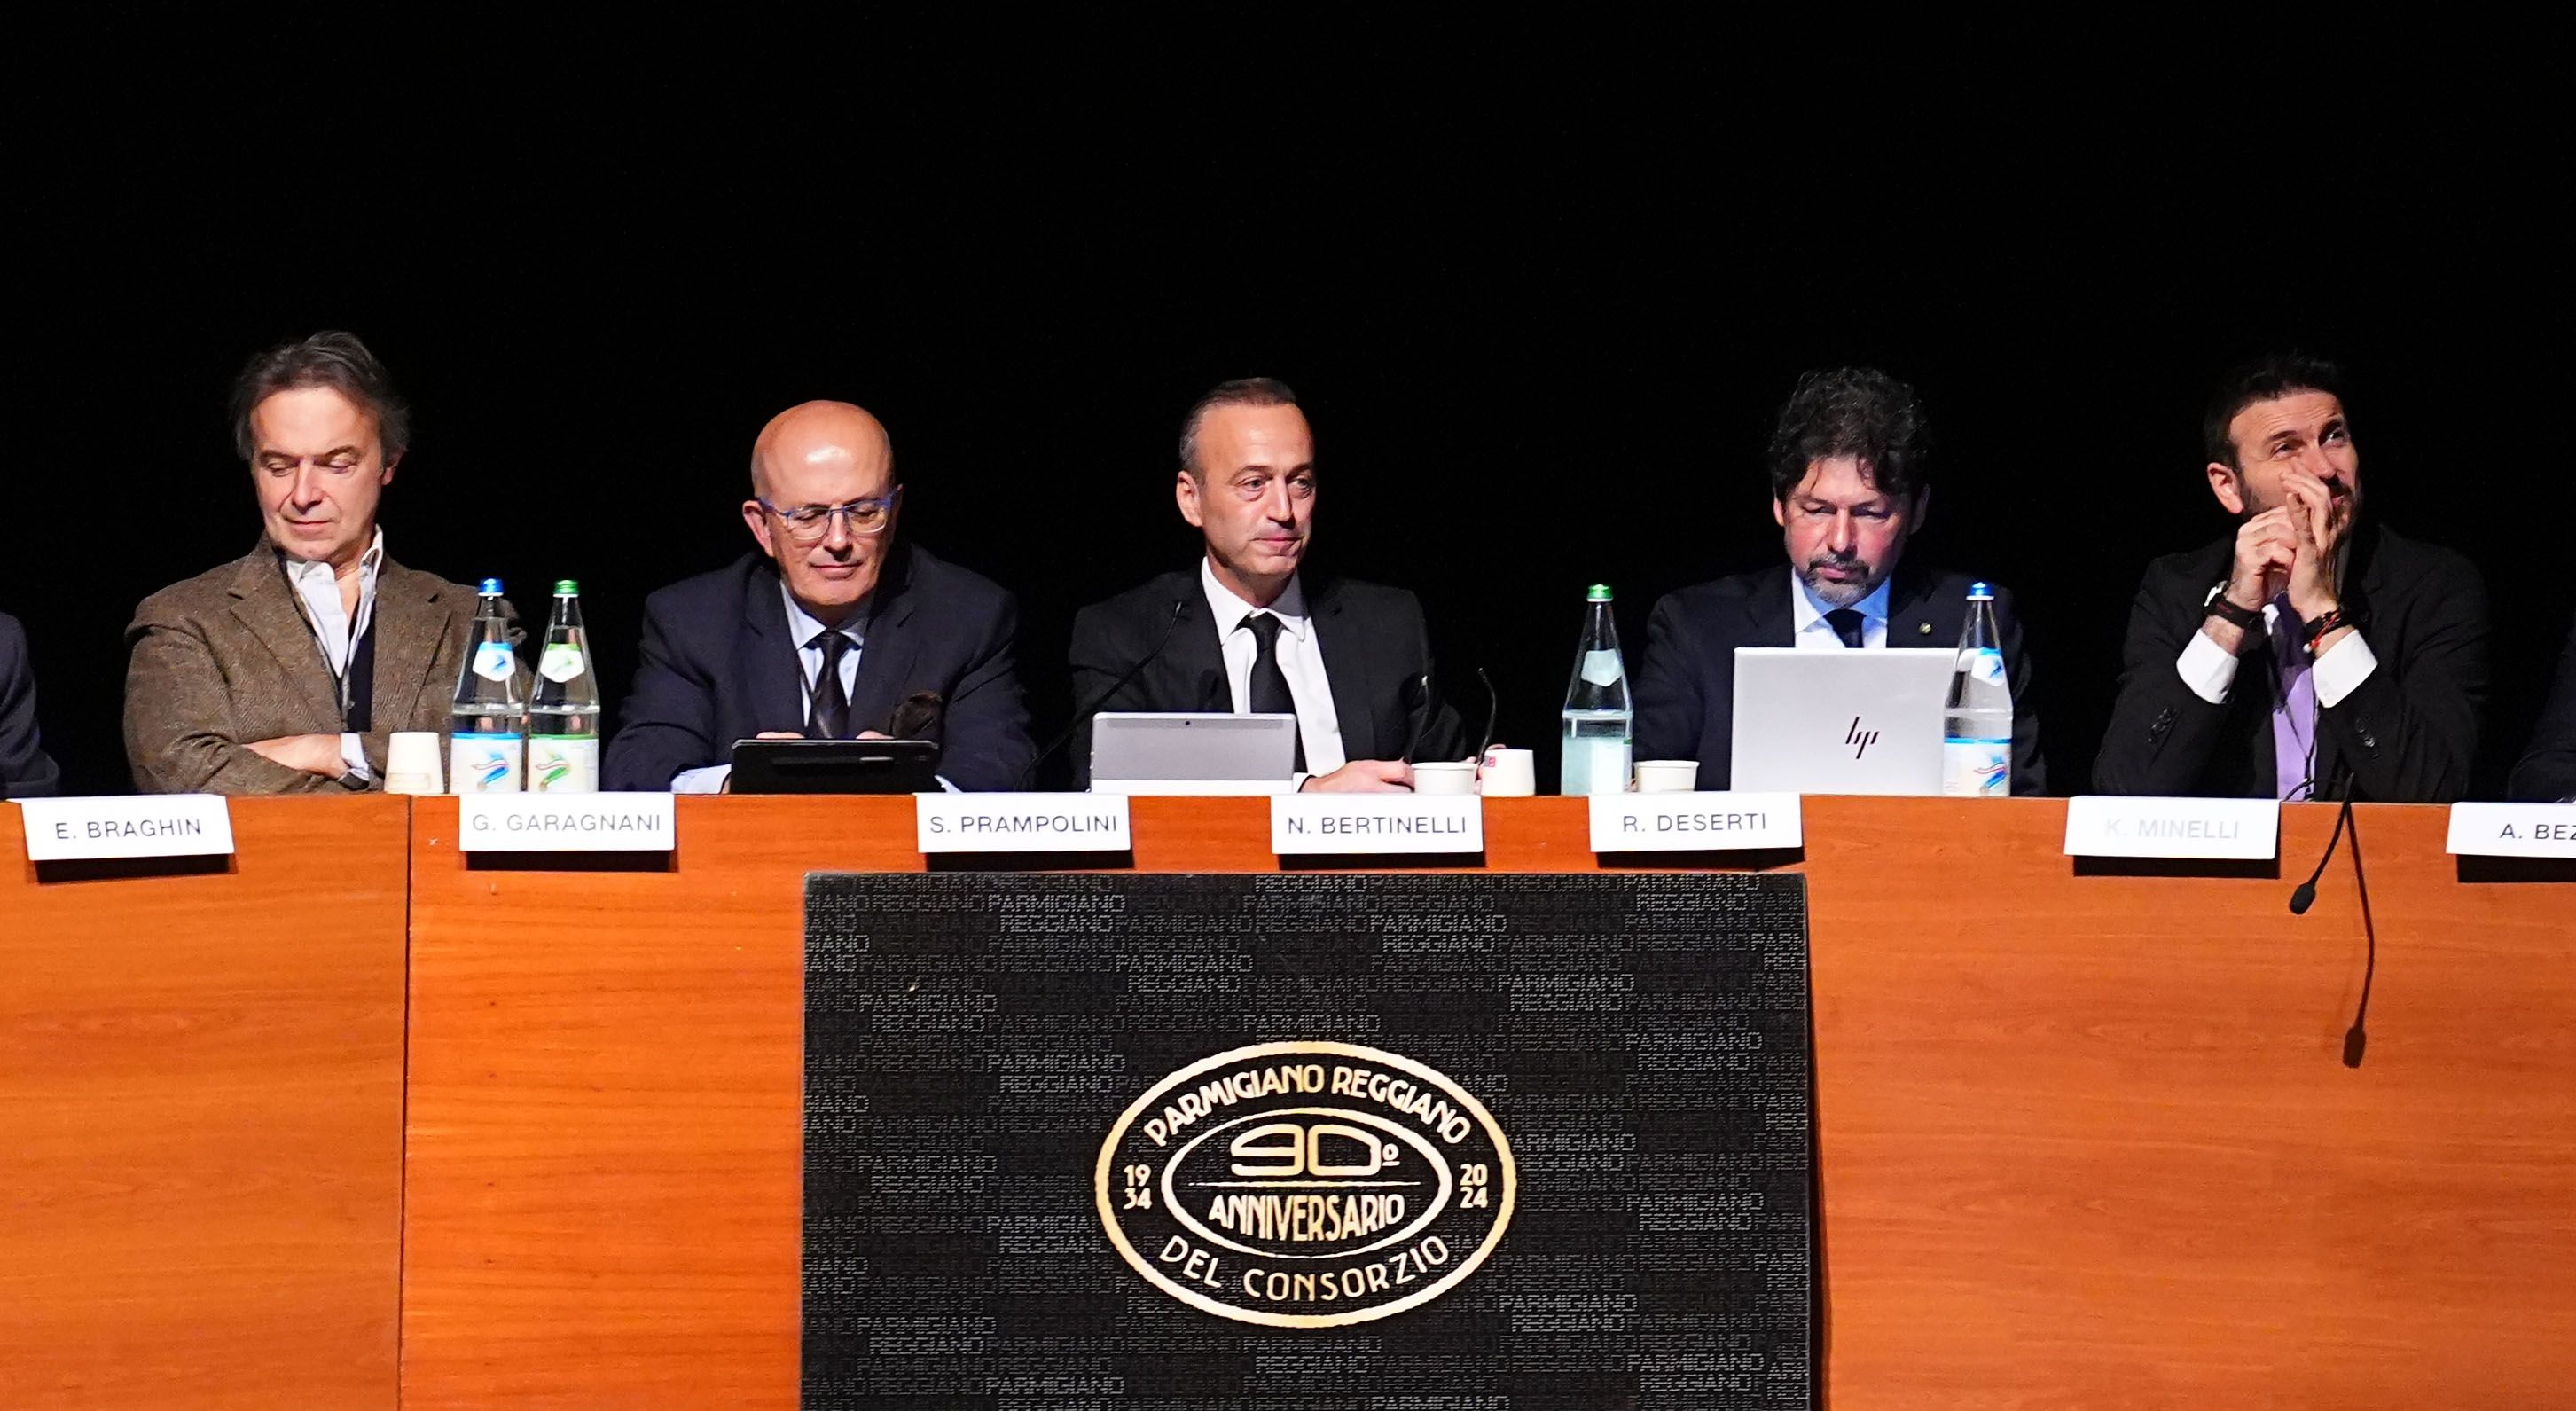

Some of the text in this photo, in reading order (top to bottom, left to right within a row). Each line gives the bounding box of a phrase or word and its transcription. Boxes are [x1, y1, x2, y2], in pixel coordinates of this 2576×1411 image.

[56, 819, 201, 839] E. BRAGHIN
[473, 814, 660, 832] G. GARAGNANI
[929, 815, 1117, 834] S. PRAMPOLINI
[1288, 816, 1466, 835] N. BERTINELLI
[1623, 813, 1766, 833] R. DESERTI
[2105, 819, 2240, 840] K. MINELLI
[2499, 823, 2523, 840] A.
[1144, 1064, 1472, 1147] PARMIGIANO REGGIANO
[1511, 1133, 1635, 1150] ARMIGIANO
[1124, 1164, 1151, 1187] 19
[1460, 1163, 1488, 1186] 20
[1123, 1187, 1152, 1210] 34
[1460, 1186, 1488, 1208] 24
[986, 1216, 1099, 1232] PARMIGIA
[1208, 1194, 1405, 1242] ANNIVERSARIO
[1159, 1235, 1449, 1301] DEL CONSORZIO
